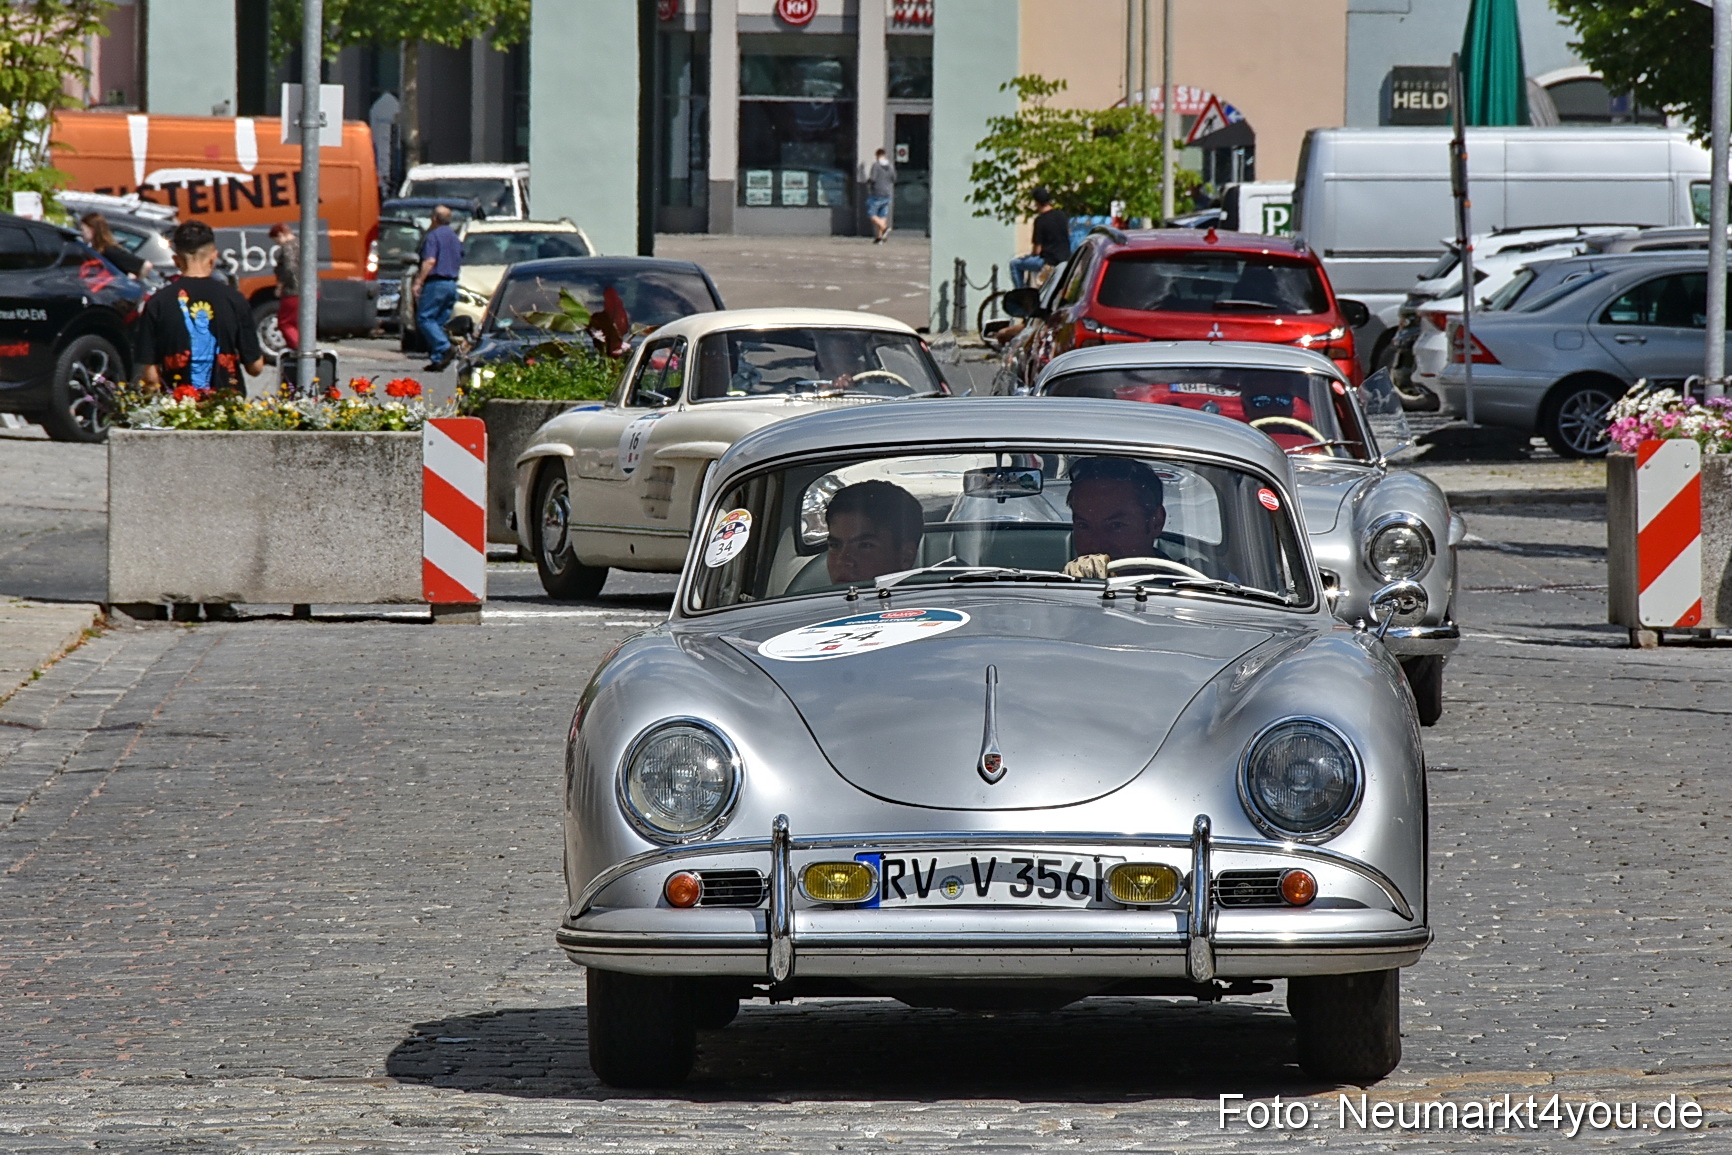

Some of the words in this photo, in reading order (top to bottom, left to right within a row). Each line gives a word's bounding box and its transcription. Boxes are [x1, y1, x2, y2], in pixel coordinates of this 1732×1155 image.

[1393, 91, 1448, 110] HELD
[629, 431, 642, 450] 16
[716, 540, 733, 556] 34
[815, 630, 883, 646] 24
[881, 858, 938, 900] RV
[970, 856, 997, 898] V
